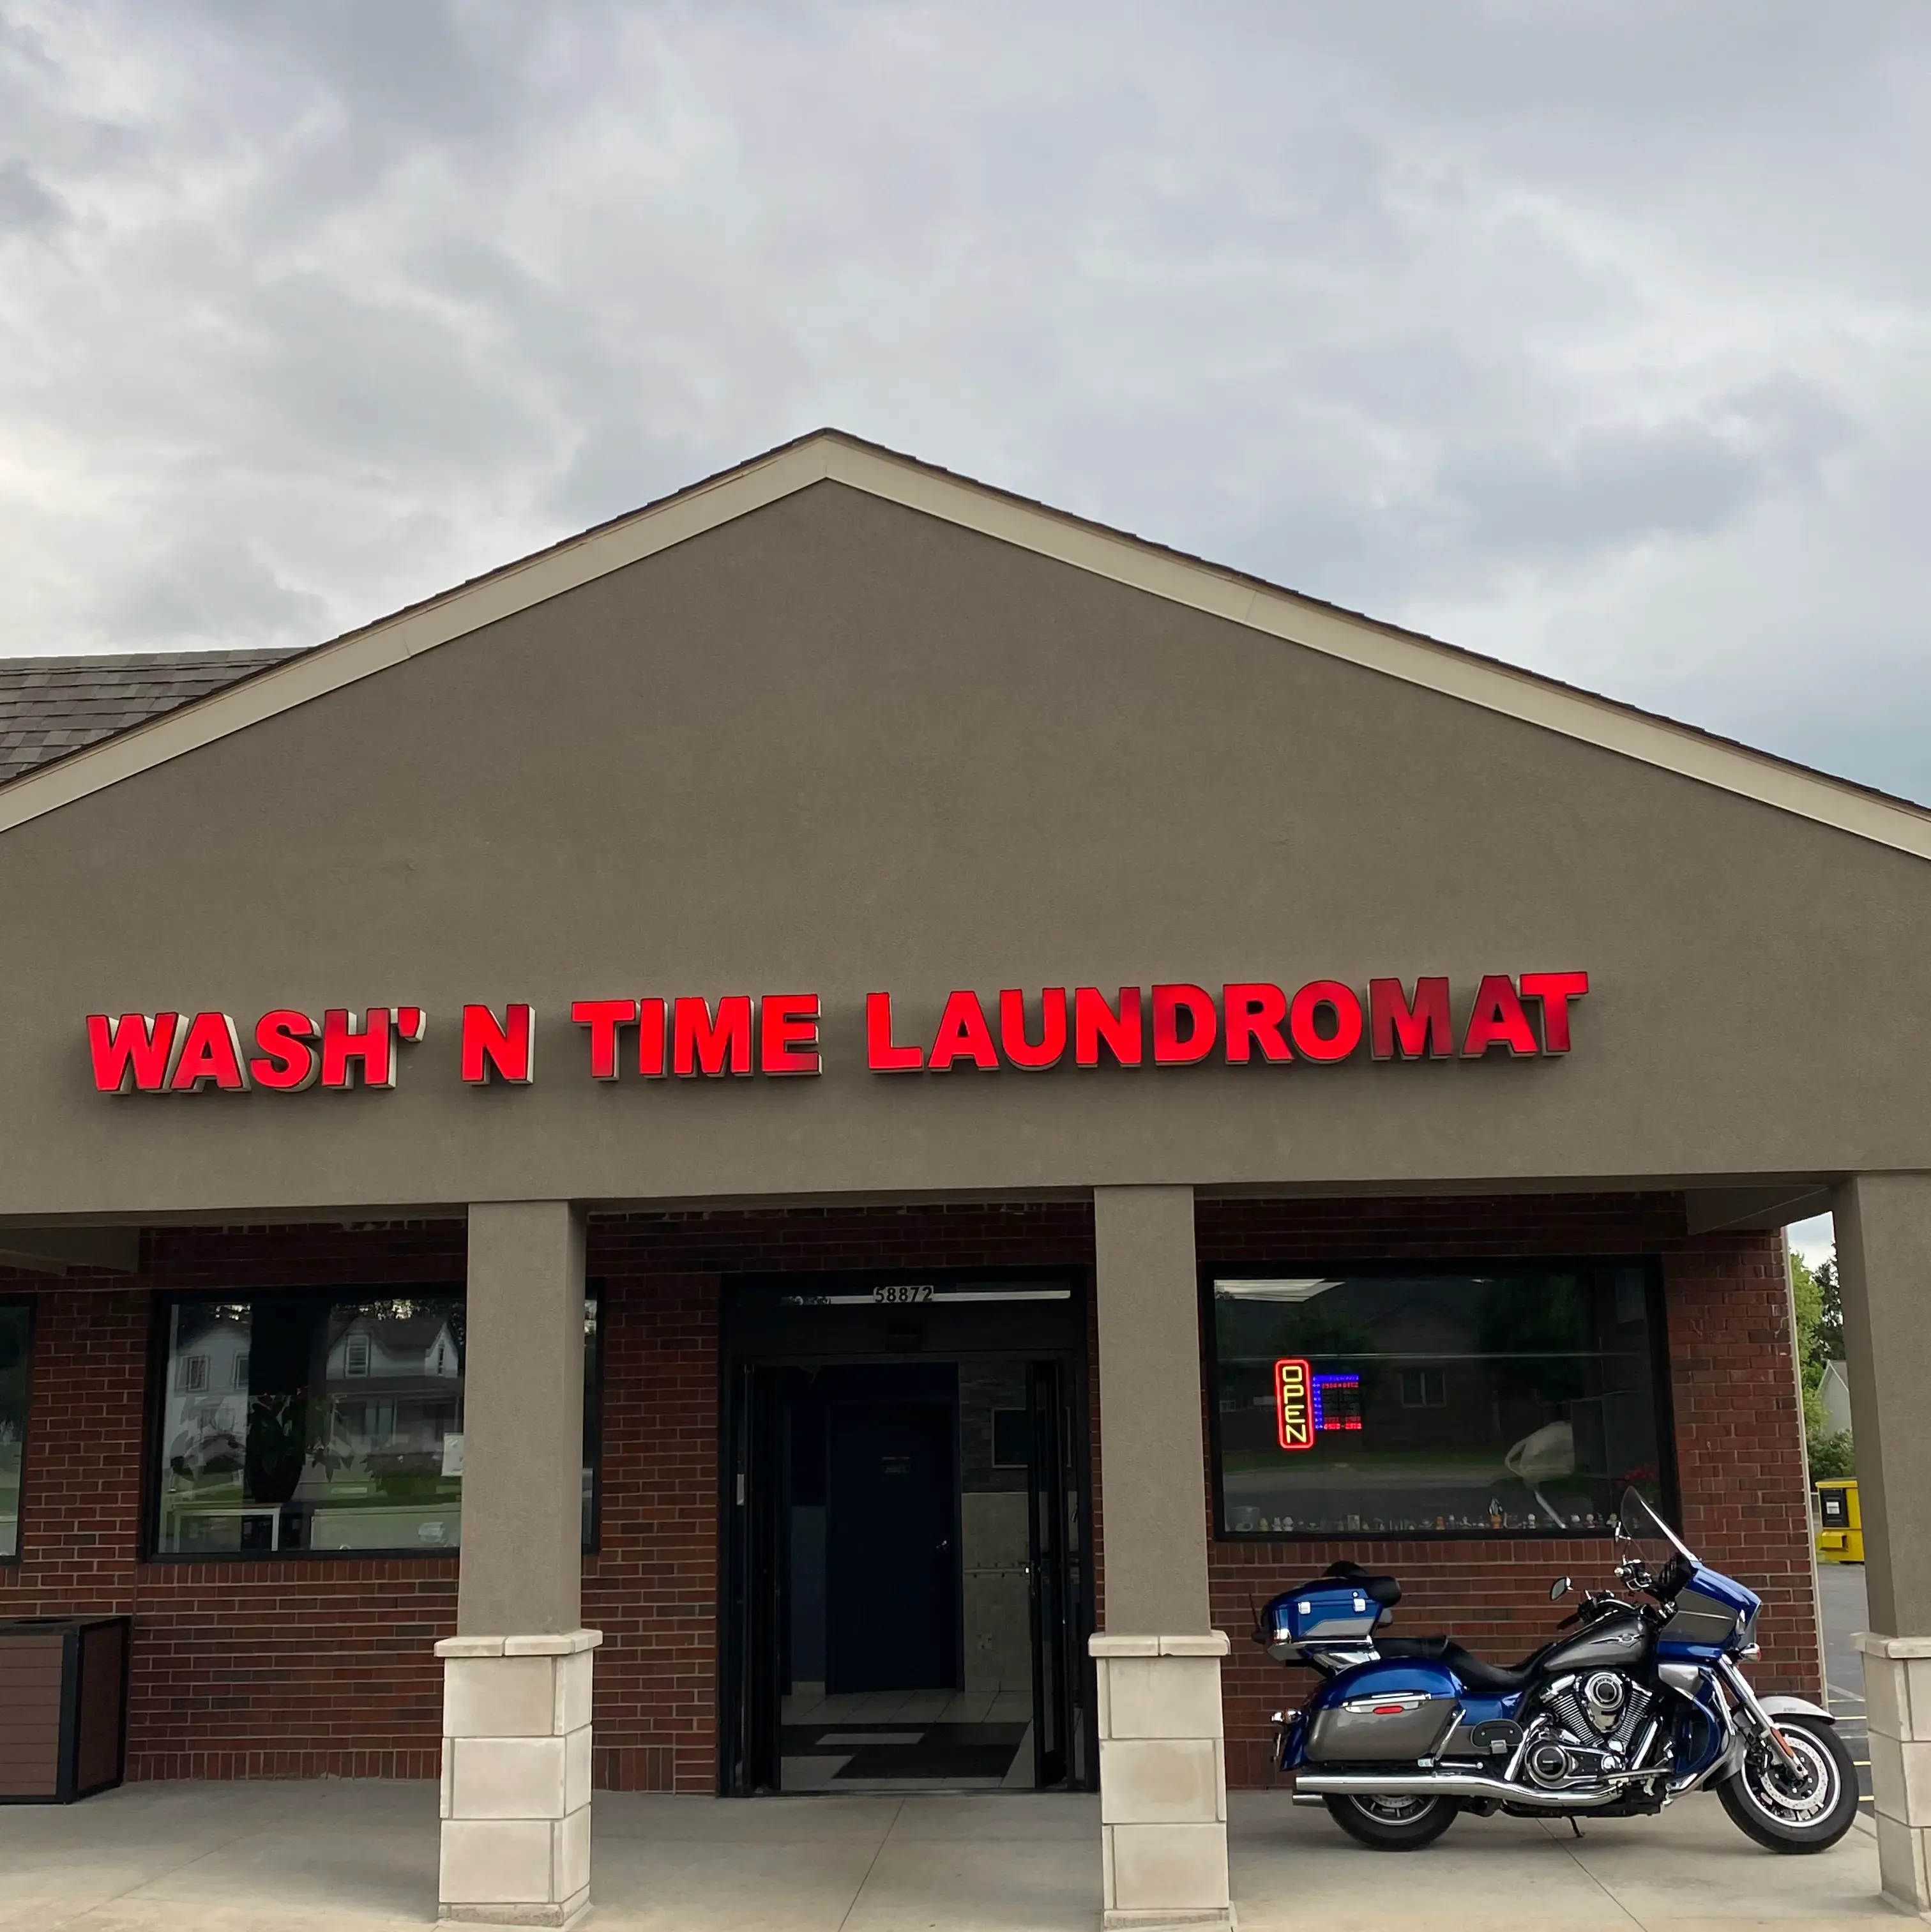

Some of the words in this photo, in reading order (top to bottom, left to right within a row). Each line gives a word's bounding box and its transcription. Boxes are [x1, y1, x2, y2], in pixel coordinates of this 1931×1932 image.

[86, 1007, 423, 1093] WASH'
[460, 1003, 533, 1086] N
[570, 993, 821, 1080] TIME
[865, 970, 1589, 1074] LAUNDROMAT
[874, 1286, 934, 1304] 58872
[1282, 1365, 1307, 1444] OPEN
